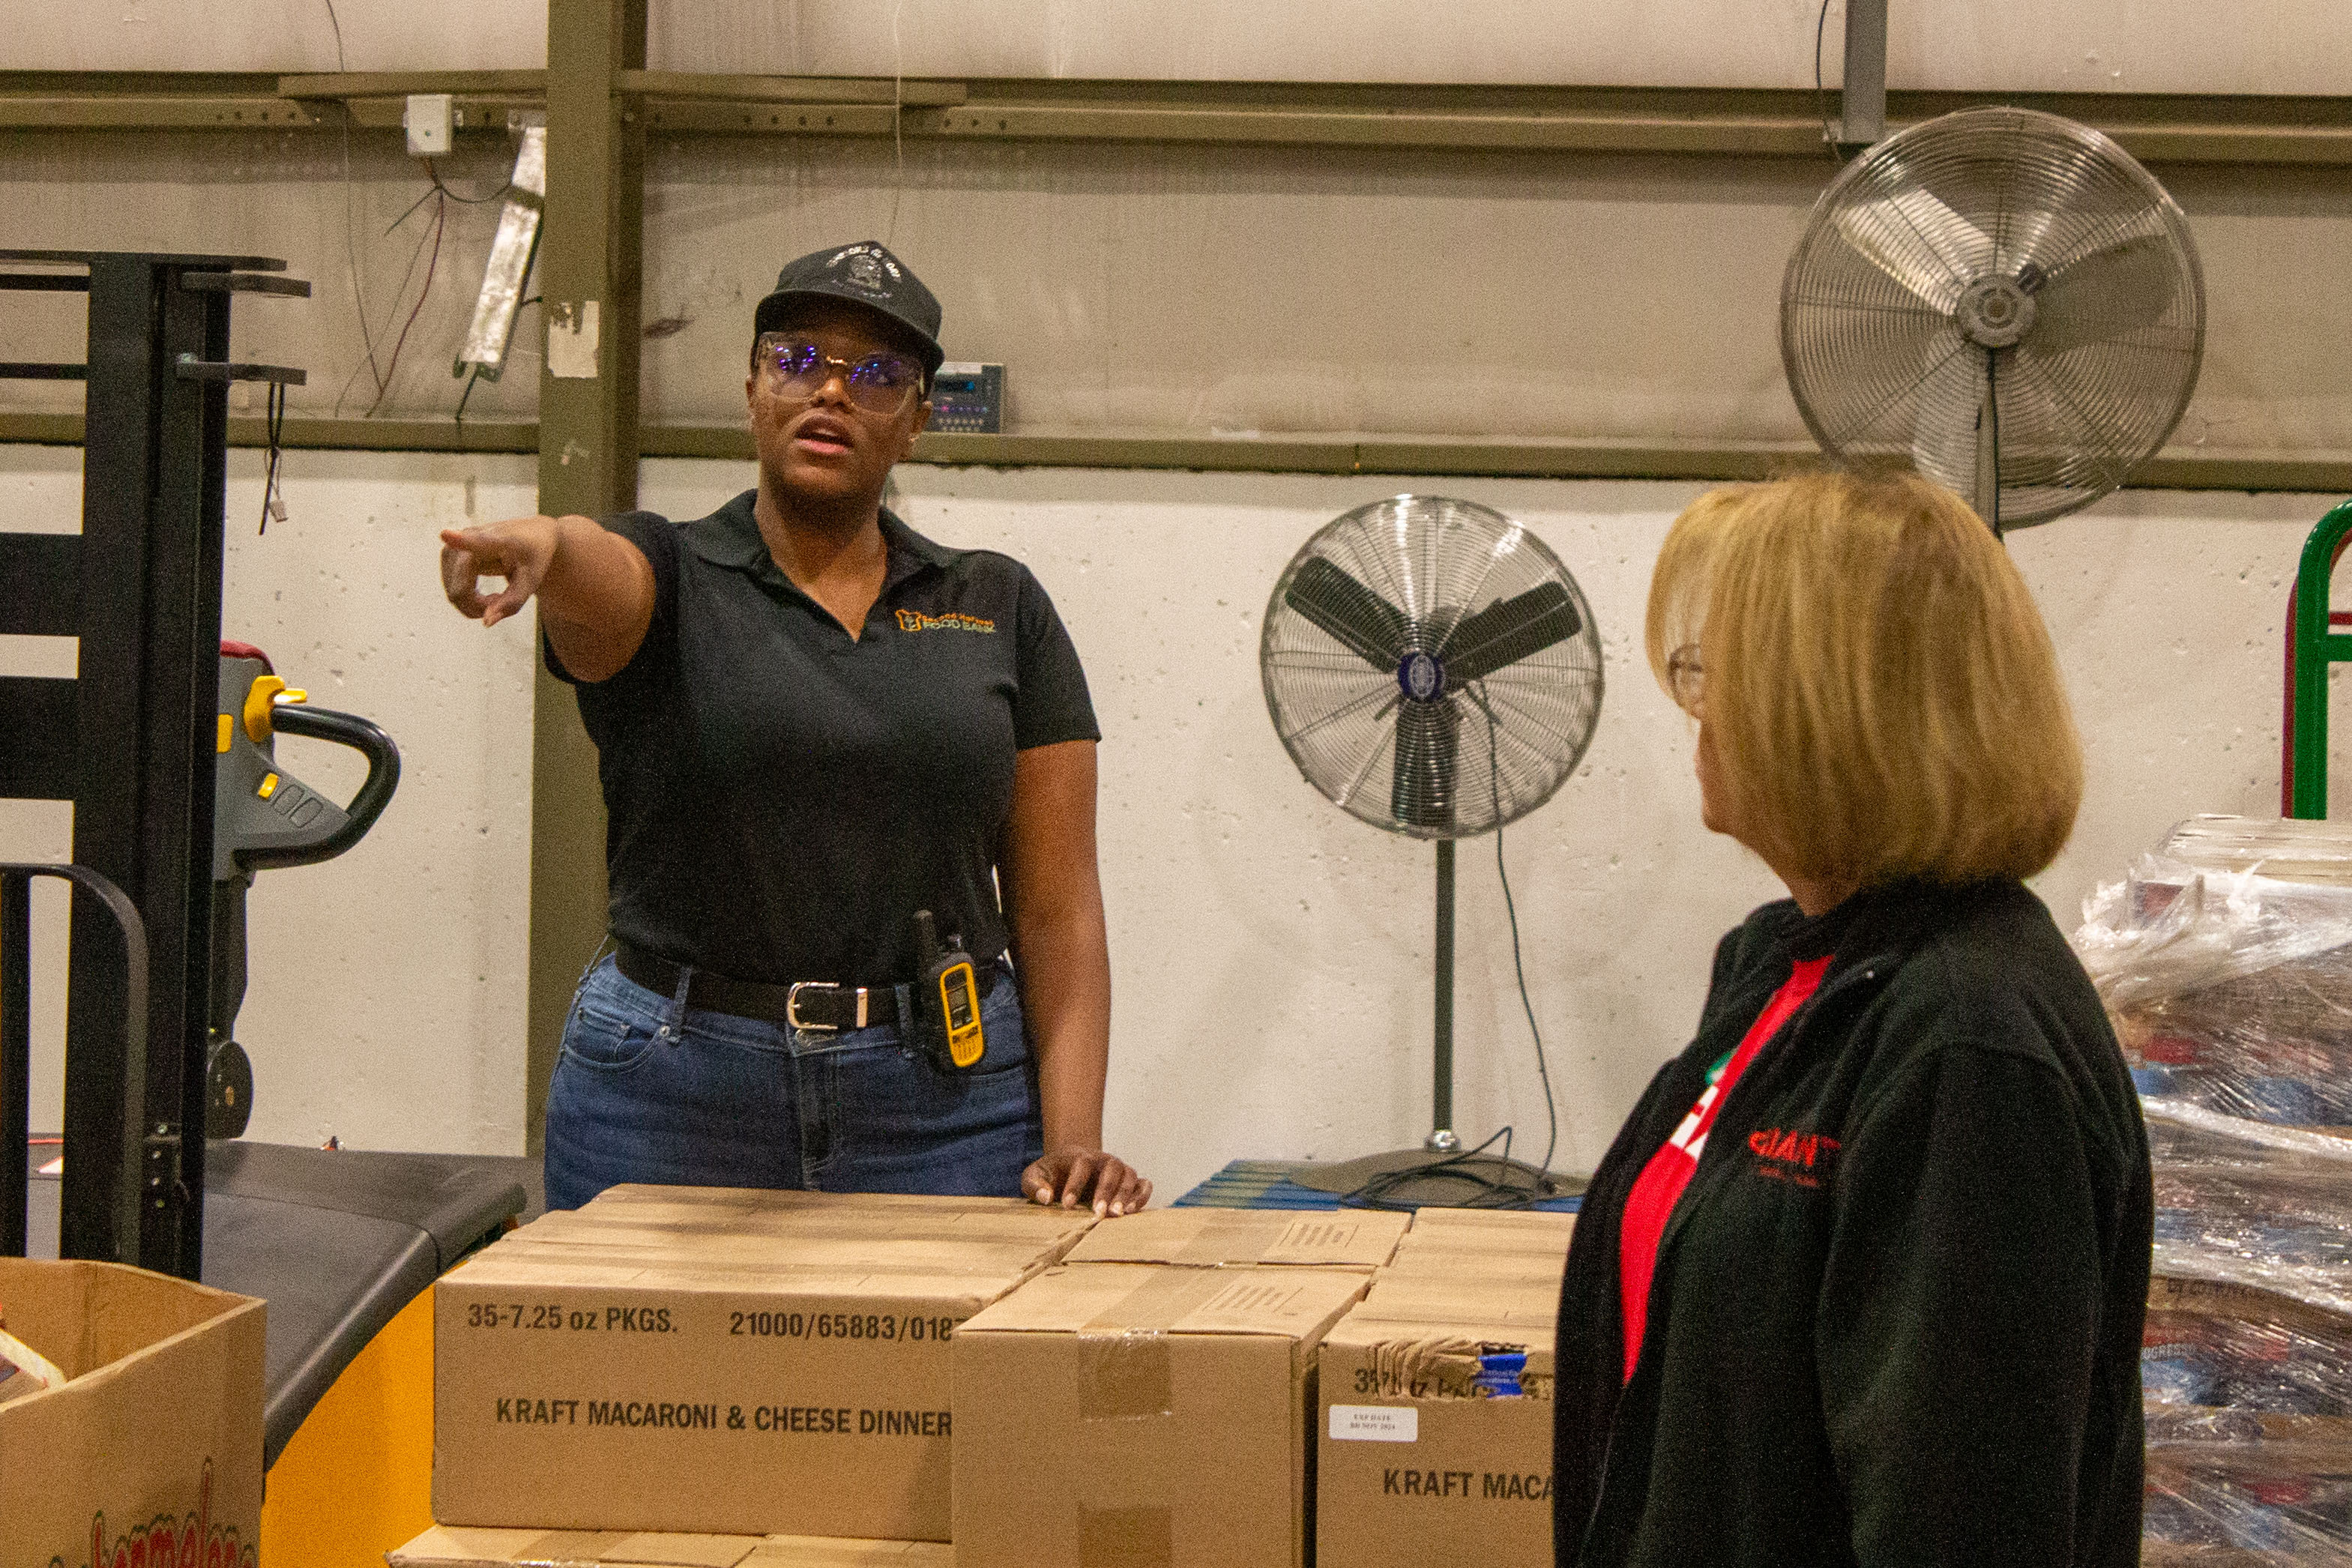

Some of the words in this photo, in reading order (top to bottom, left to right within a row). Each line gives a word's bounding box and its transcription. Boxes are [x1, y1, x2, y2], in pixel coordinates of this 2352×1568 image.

[468, 1303, 562, 1330] 35-7.25
[569, 1310, 598, 1331] oz
[606, 1306, 678, 1333] PKGS.
[729, 1311, 969, 1342] 21000/65883/018
[496, 1397, 579, 1424] KRAFT
[588, 1399, 717, 1430] MACARONI
[726, 1405, 746, 1430] &
[754, 1405, 851, 1433] CHEESE
[860, 1408, 953, 1437] DINNER
[1383, 1468, 1474, 1497] KRAFT
